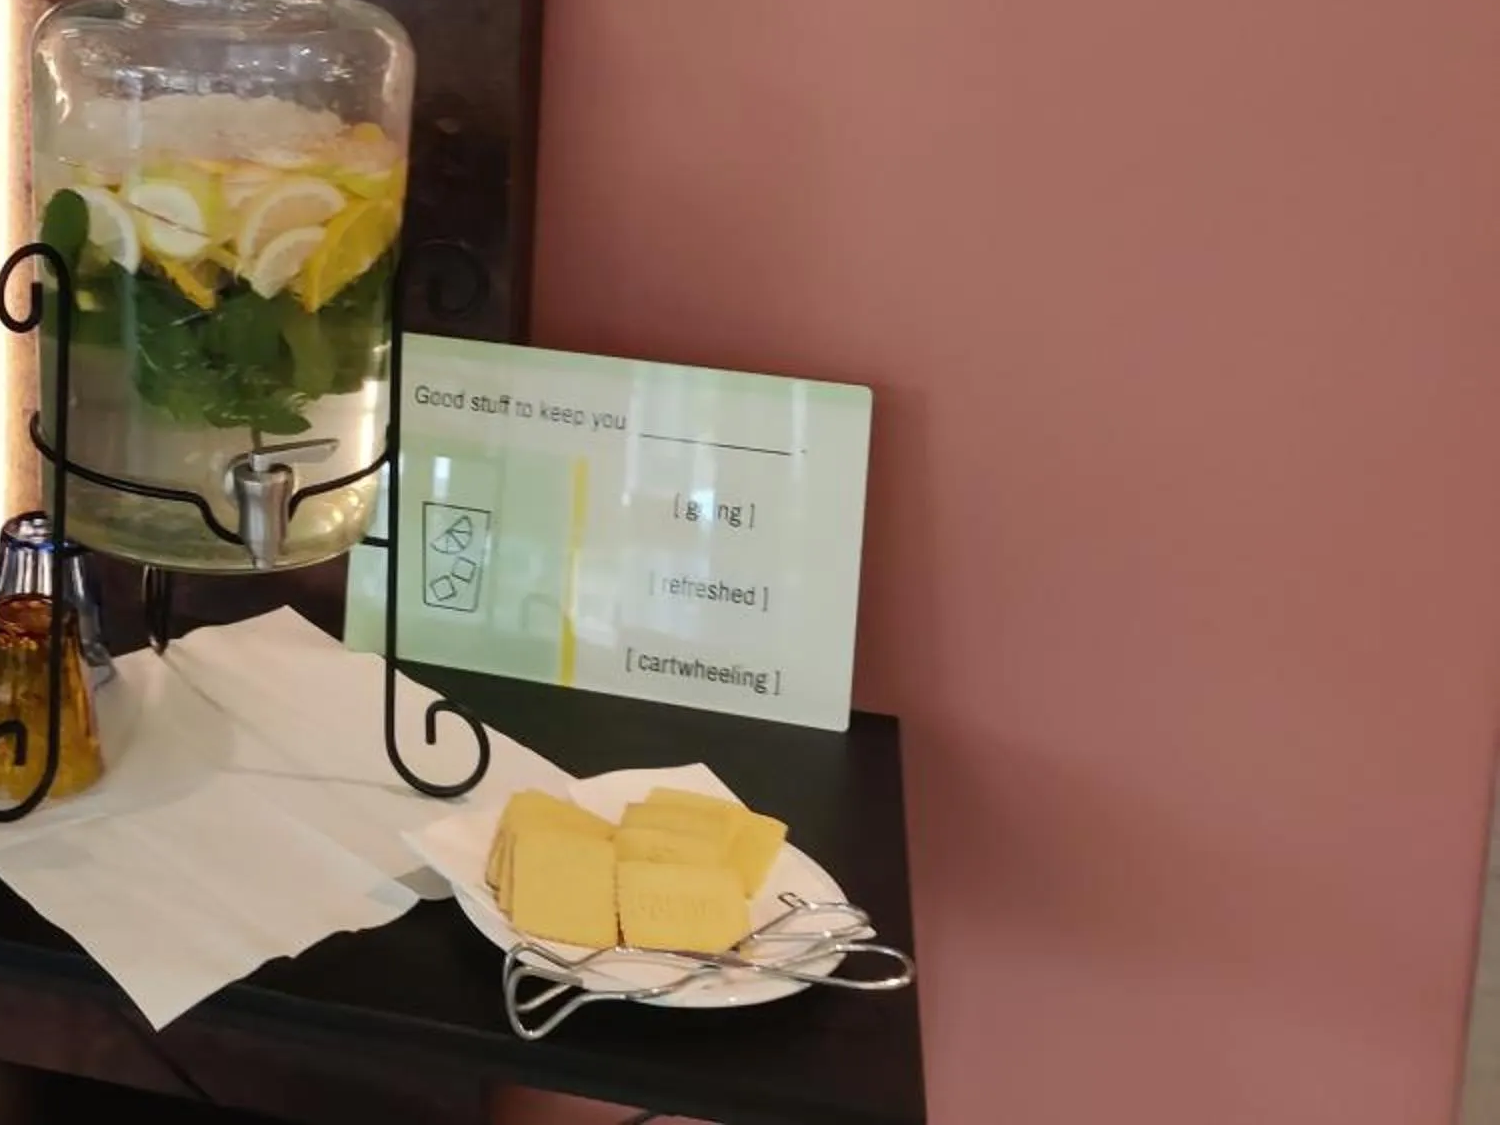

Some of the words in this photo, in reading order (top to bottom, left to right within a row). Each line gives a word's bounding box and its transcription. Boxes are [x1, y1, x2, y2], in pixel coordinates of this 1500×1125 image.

[414, 384, 466, 410] Good
[470, 393, 511, 416] stuff
[515, 398, 534, 418] to
[540, 399, 585, 428] keep
[591, 410, 628, 432] you
[685, 499, 742, 529] gng
[661, 575, 756, 606] refreshed
[637, 652, 769, 695] cartwheeling
